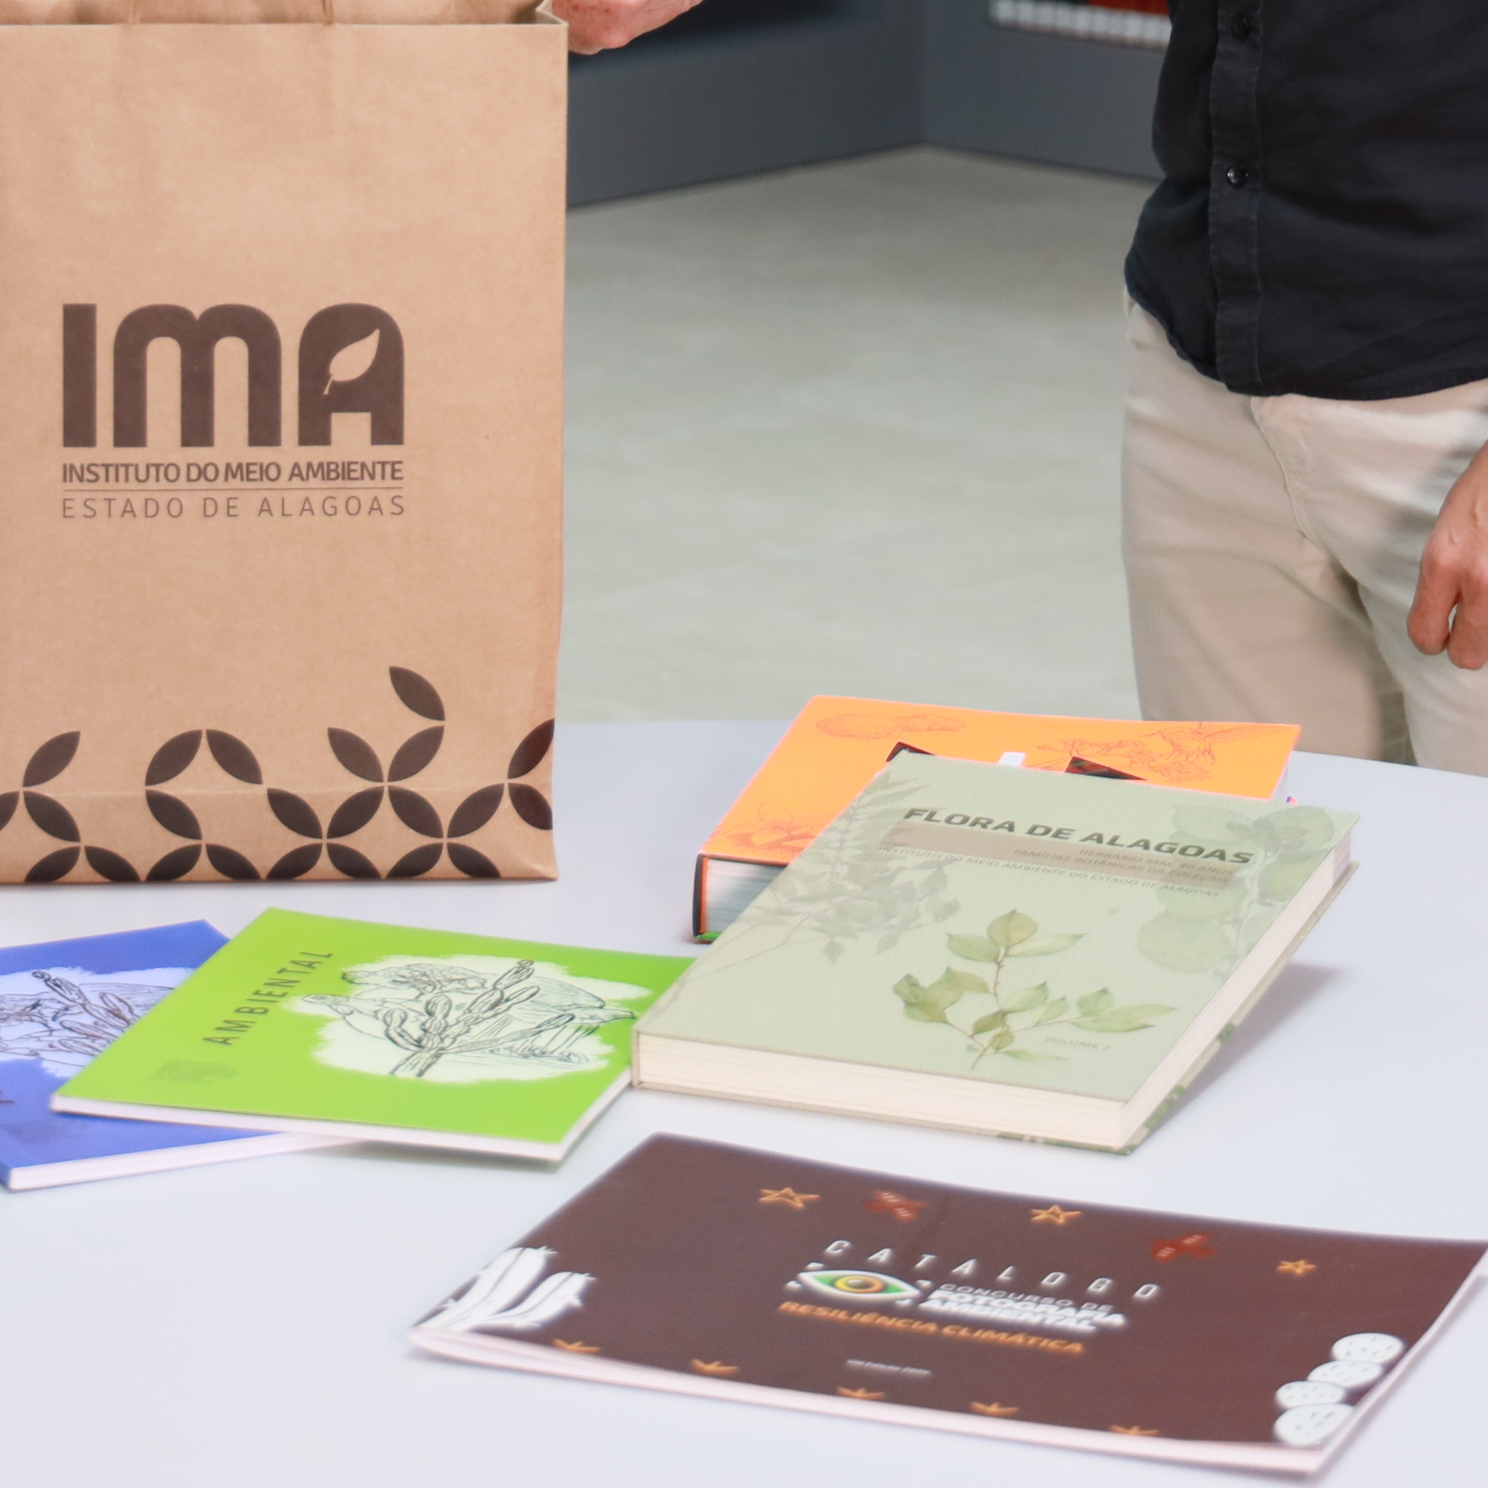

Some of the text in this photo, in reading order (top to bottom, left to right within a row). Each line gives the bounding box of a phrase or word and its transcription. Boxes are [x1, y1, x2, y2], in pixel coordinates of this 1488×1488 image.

[62, 303, 404, 448] IMA
[63, 461, 404, 483] INSTITUTO DO MEIO AMBIENTE
[63, 495, 405, 519] ESTADO DE ALAGOAS
[903, 808, 1255, 865] FLORA DE ALAGOAS
[878, 846, 942, 859] INSTITUTO
[966, 857, 1000, 866] MEIO
[1001, 861, 1066, 876] AMBIENTE
[1069, 871, 1088, 879] DO
[1091, 874, 1139, 886] ESTADO
[1159, 883, 1220, 897] ALAGOAS
[202, 951, 334, 1046] AMBIENTAL
[917, 1298, 1097, 1334] AMBIENTAL
[927, 1289, 1126, 1327] FOTOGRAFIA
[940, 1283, 1114, 1312] CONCURSO DE
[778, 1300, 1086, 1355] RESILIÊNCIA CLIMÁTICA
